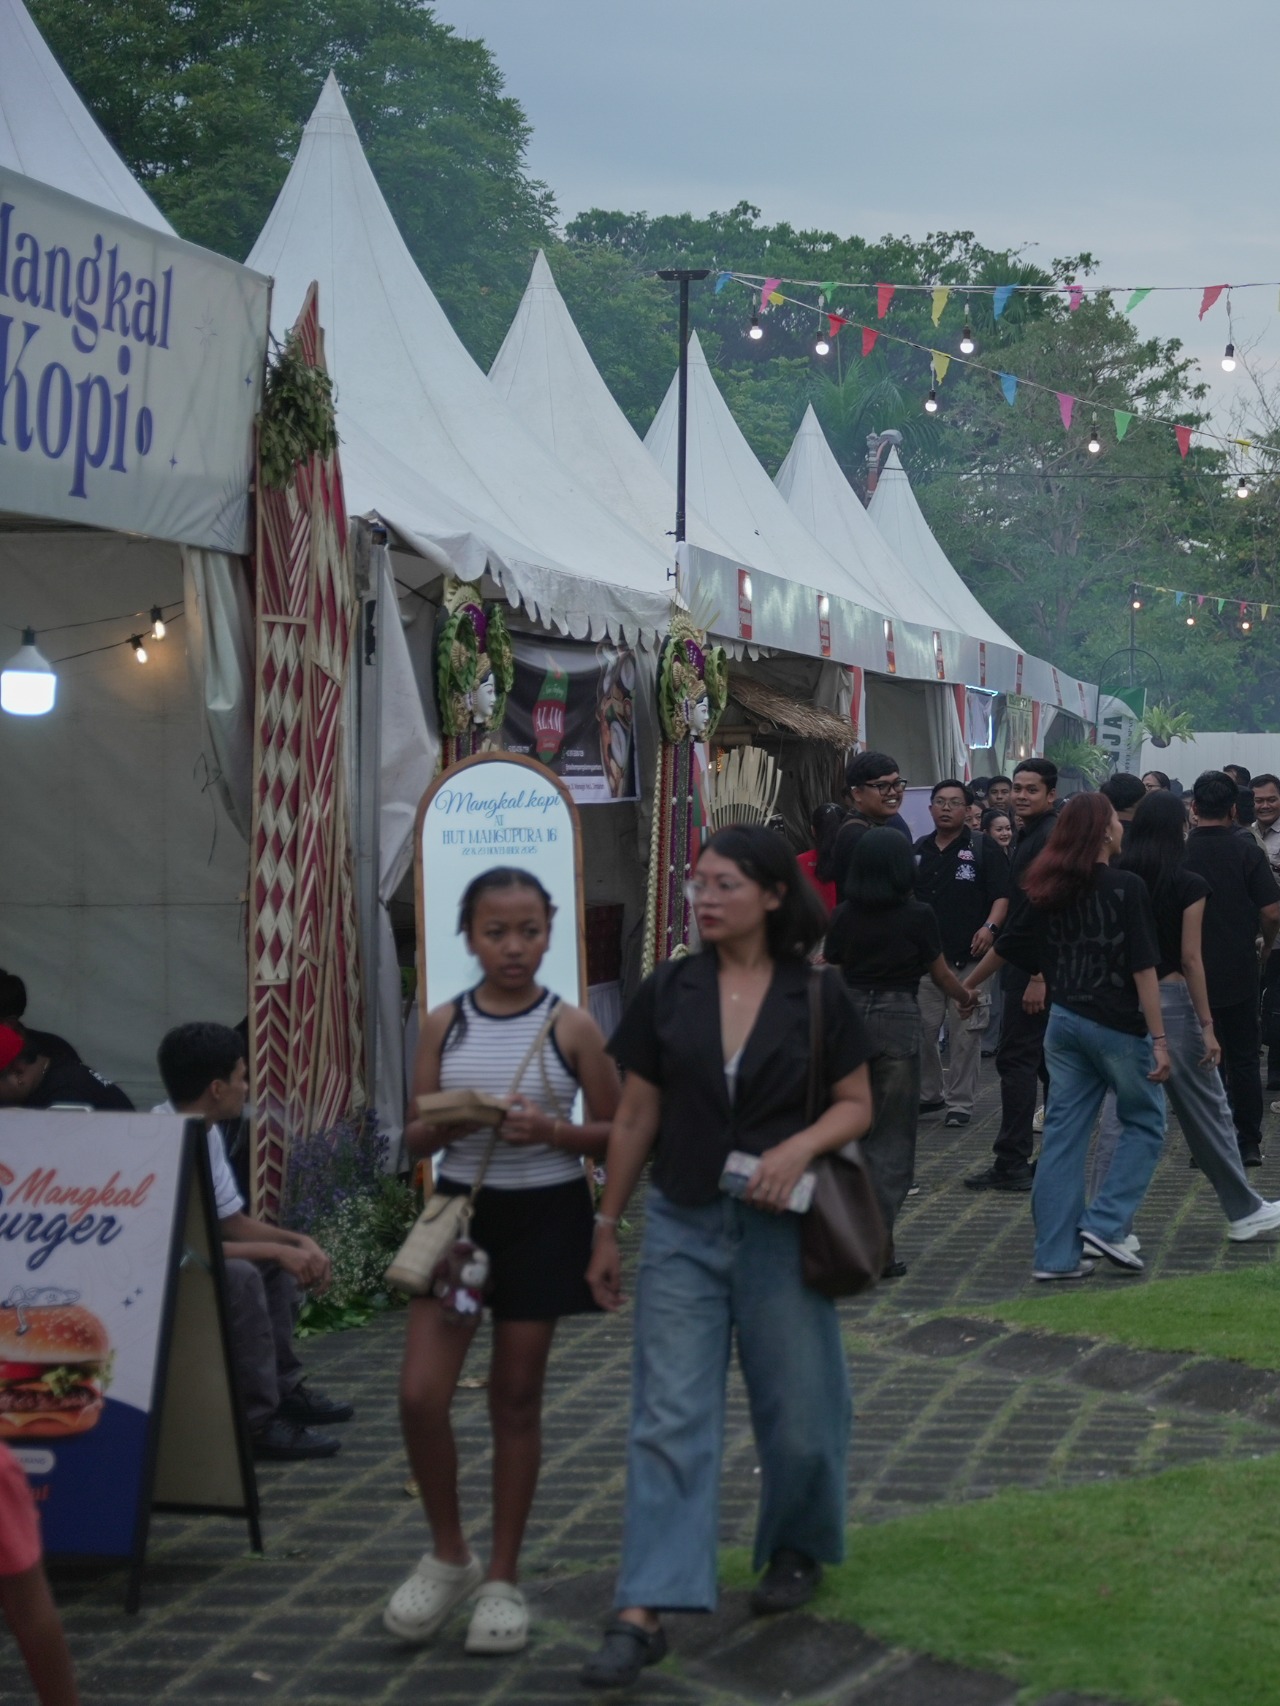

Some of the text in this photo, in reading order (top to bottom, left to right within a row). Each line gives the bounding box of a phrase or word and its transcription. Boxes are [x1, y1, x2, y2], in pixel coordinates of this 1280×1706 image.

[435, 789, 561, 818] Mangkal kopi
[442, 827, 558, 845] HUT MANGUPURA 16
[6, 1167, 155, 1224] Mangkal
[0, 1212, 123, 1271] urger
